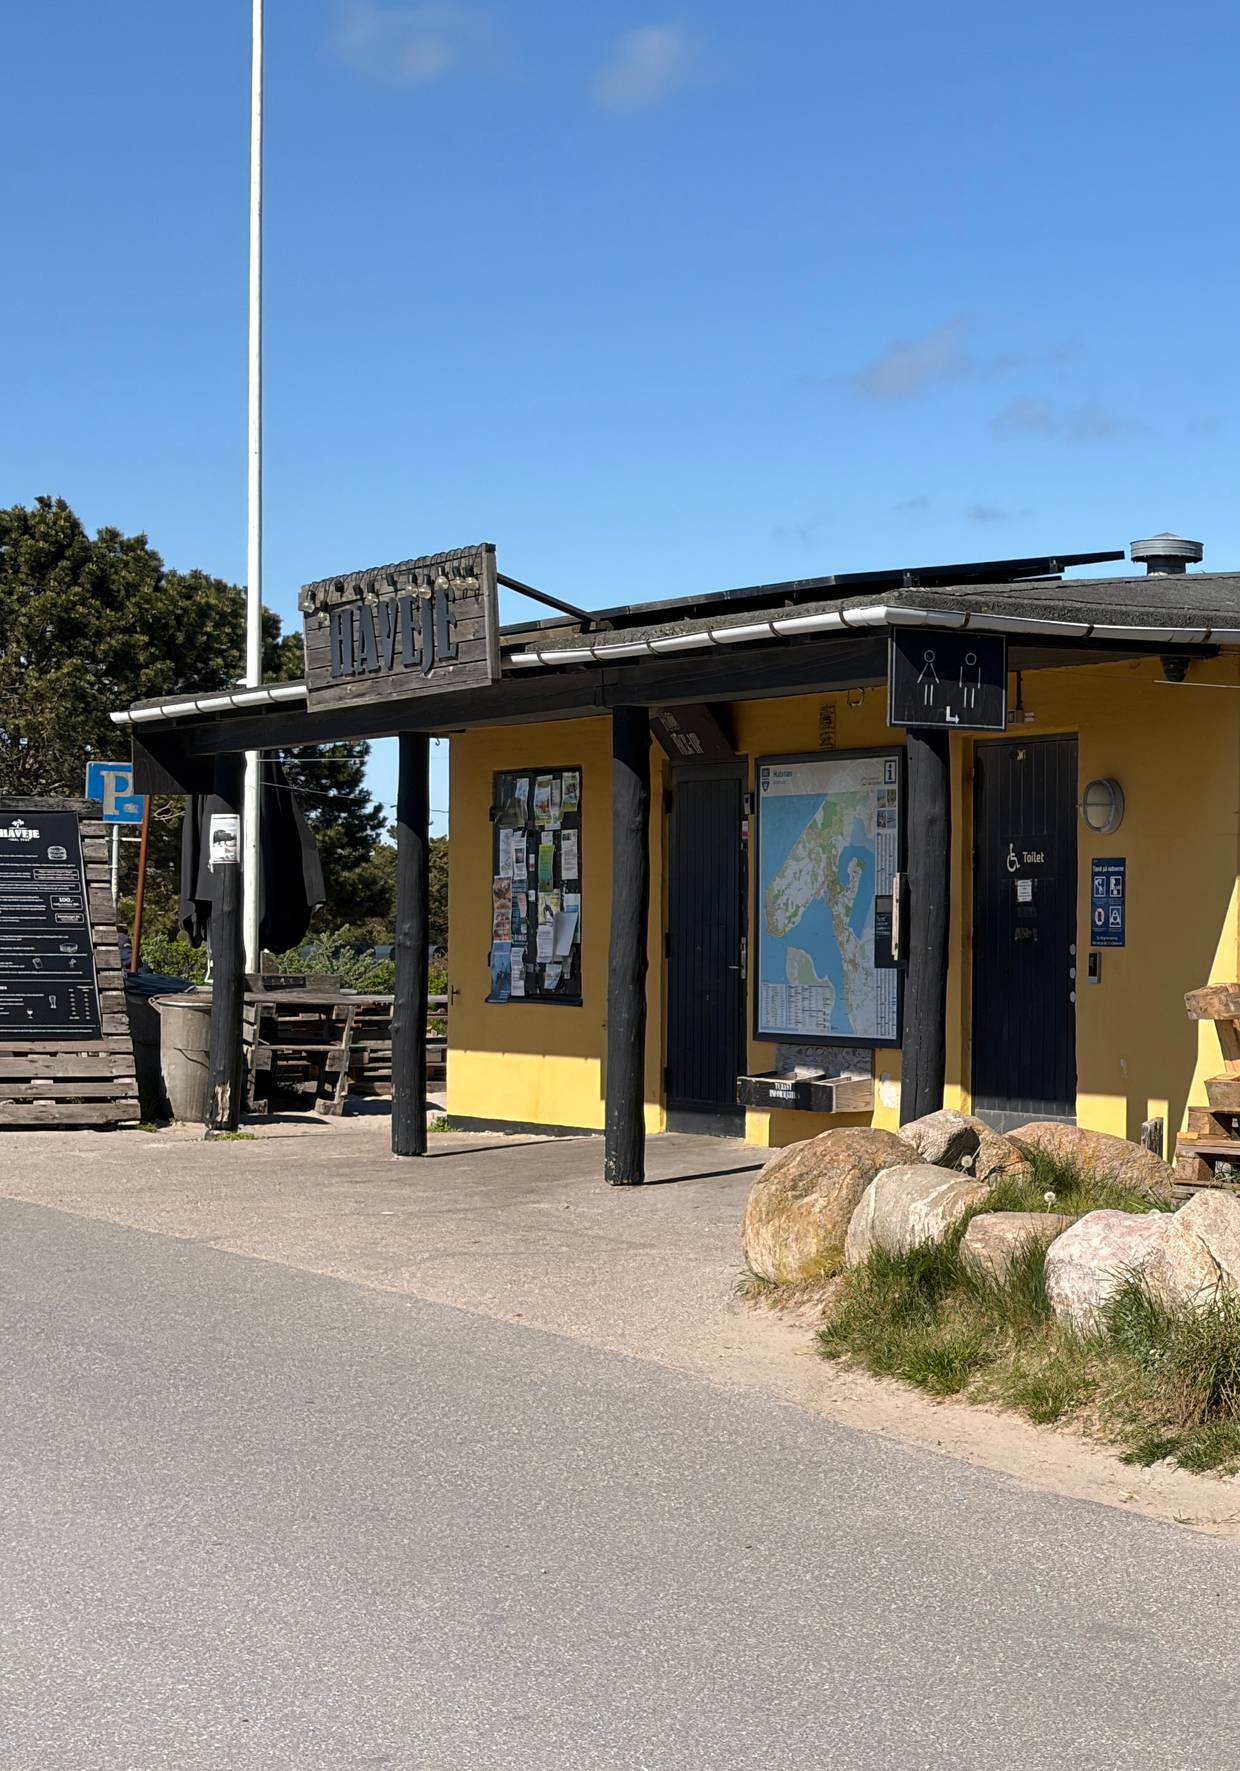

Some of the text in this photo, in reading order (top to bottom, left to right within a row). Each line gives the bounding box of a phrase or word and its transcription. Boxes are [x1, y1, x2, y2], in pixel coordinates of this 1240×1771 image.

[329, 586, 460, 676] HAVEJE
[100, 770, 135, 816] P
[1022, 851, 1045, 864] Toilet
